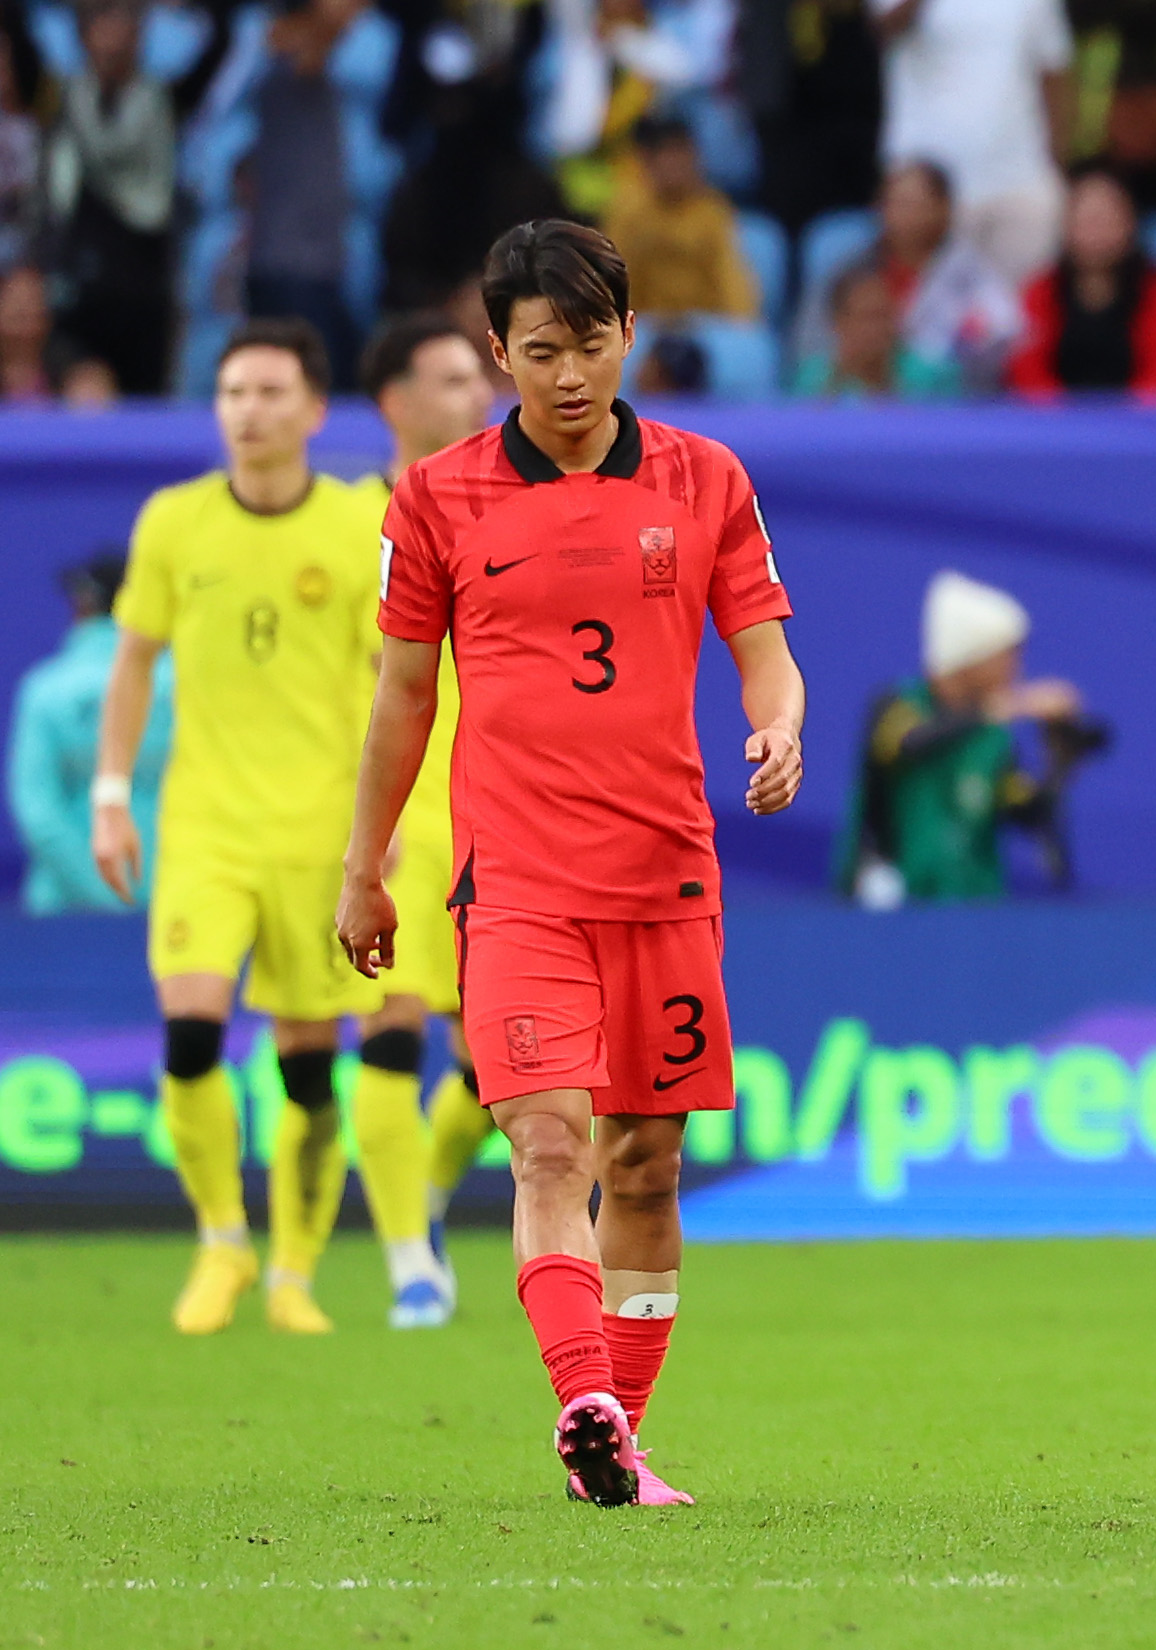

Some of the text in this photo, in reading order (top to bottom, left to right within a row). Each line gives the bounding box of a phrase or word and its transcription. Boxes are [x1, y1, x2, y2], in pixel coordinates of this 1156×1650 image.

[643, 588, 676, 599] KOREA
[243, 596, 280, 666] 8
[571, 619, 617, 694] 3
[662, 994, 707, 1064] 3
